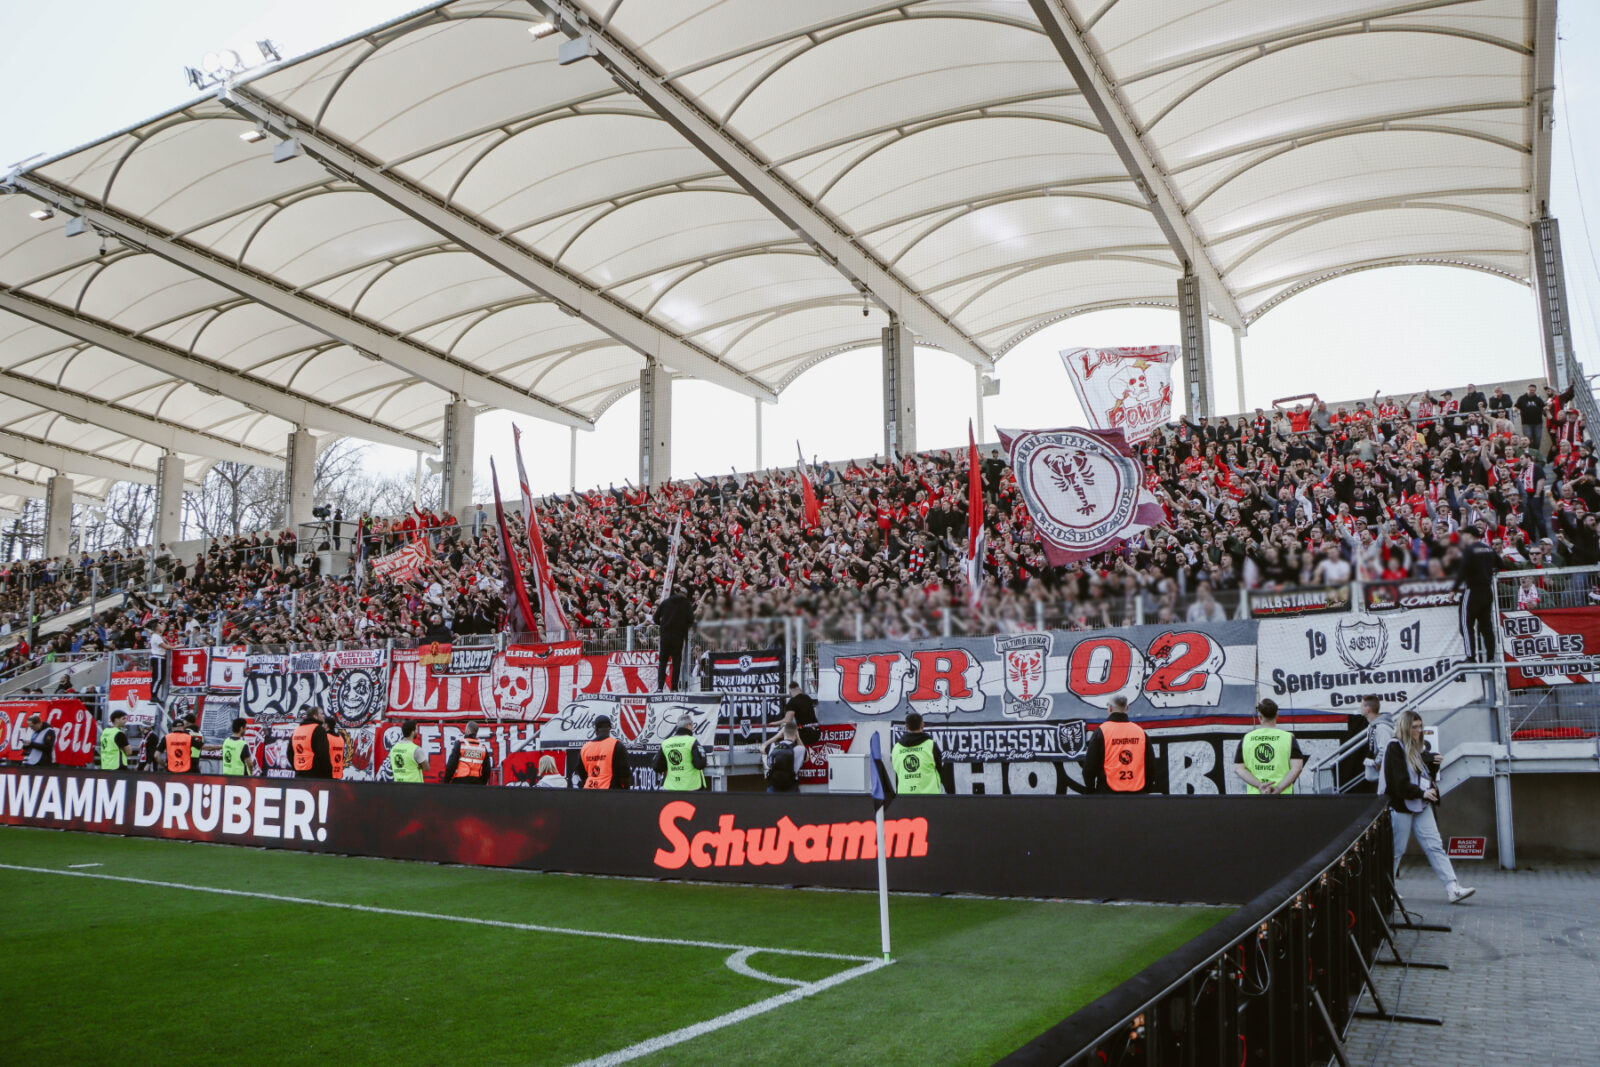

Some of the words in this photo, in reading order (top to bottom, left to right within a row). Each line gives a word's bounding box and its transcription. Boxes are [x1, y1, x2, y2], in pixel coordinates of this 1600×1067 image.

[1502, 616, 1543, 638] RED
[1305, 628, 1327, 660] 19
[1399, 620, 1421, 654] 97
[1511, 634, 1585, 658] EAGLES
[505, 650, 534, 658] ELSTER
[553, 647, 581, 657] FRONT
[607, 651, 659, 665] JUNGSC
[341, 657, 376, 665] BERLIN
[111, 677, 153, 685] REISEGRUPP
[712, 672, 780, 686] PSEUDOFANS
[834, 647, 985, 715] UR
[1111, 737, 1140, 746] SICHERHEIT
[1119, 771, 1134, 780] 23
[133, 780, 330, 843] DRÜBER!
[653, 800, 929, 870] Schwamm
